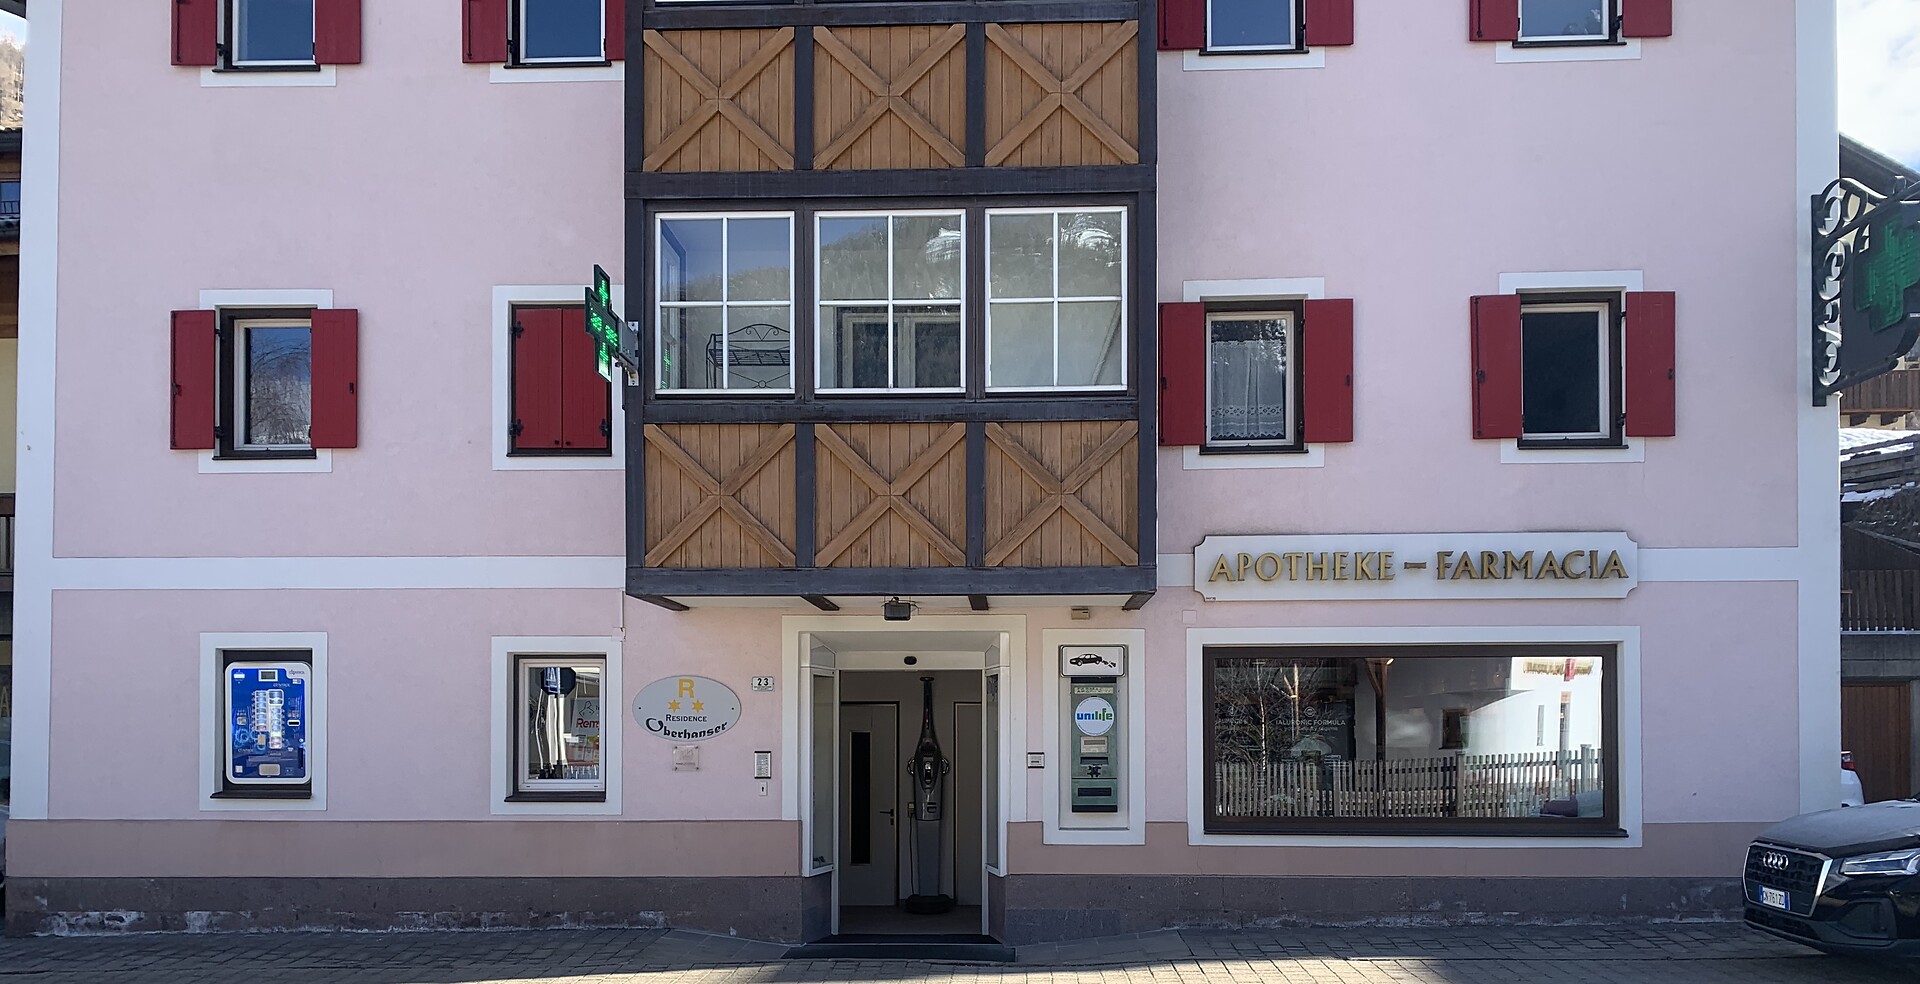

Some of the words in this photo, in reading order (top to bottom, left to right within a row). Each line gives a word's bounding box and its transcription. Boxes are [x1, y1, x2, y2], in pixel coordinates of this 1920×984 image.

[1208, 551, 1395, 582] APOTHEKE
[1436, 549, 1629, 580] FARMACIA
[678, 678, 695, 698] R
[757, 677, 769, 686] 23
[1076, 707, 1113, 721] unilife
[645, 717, 728, 740] Oberhanser
